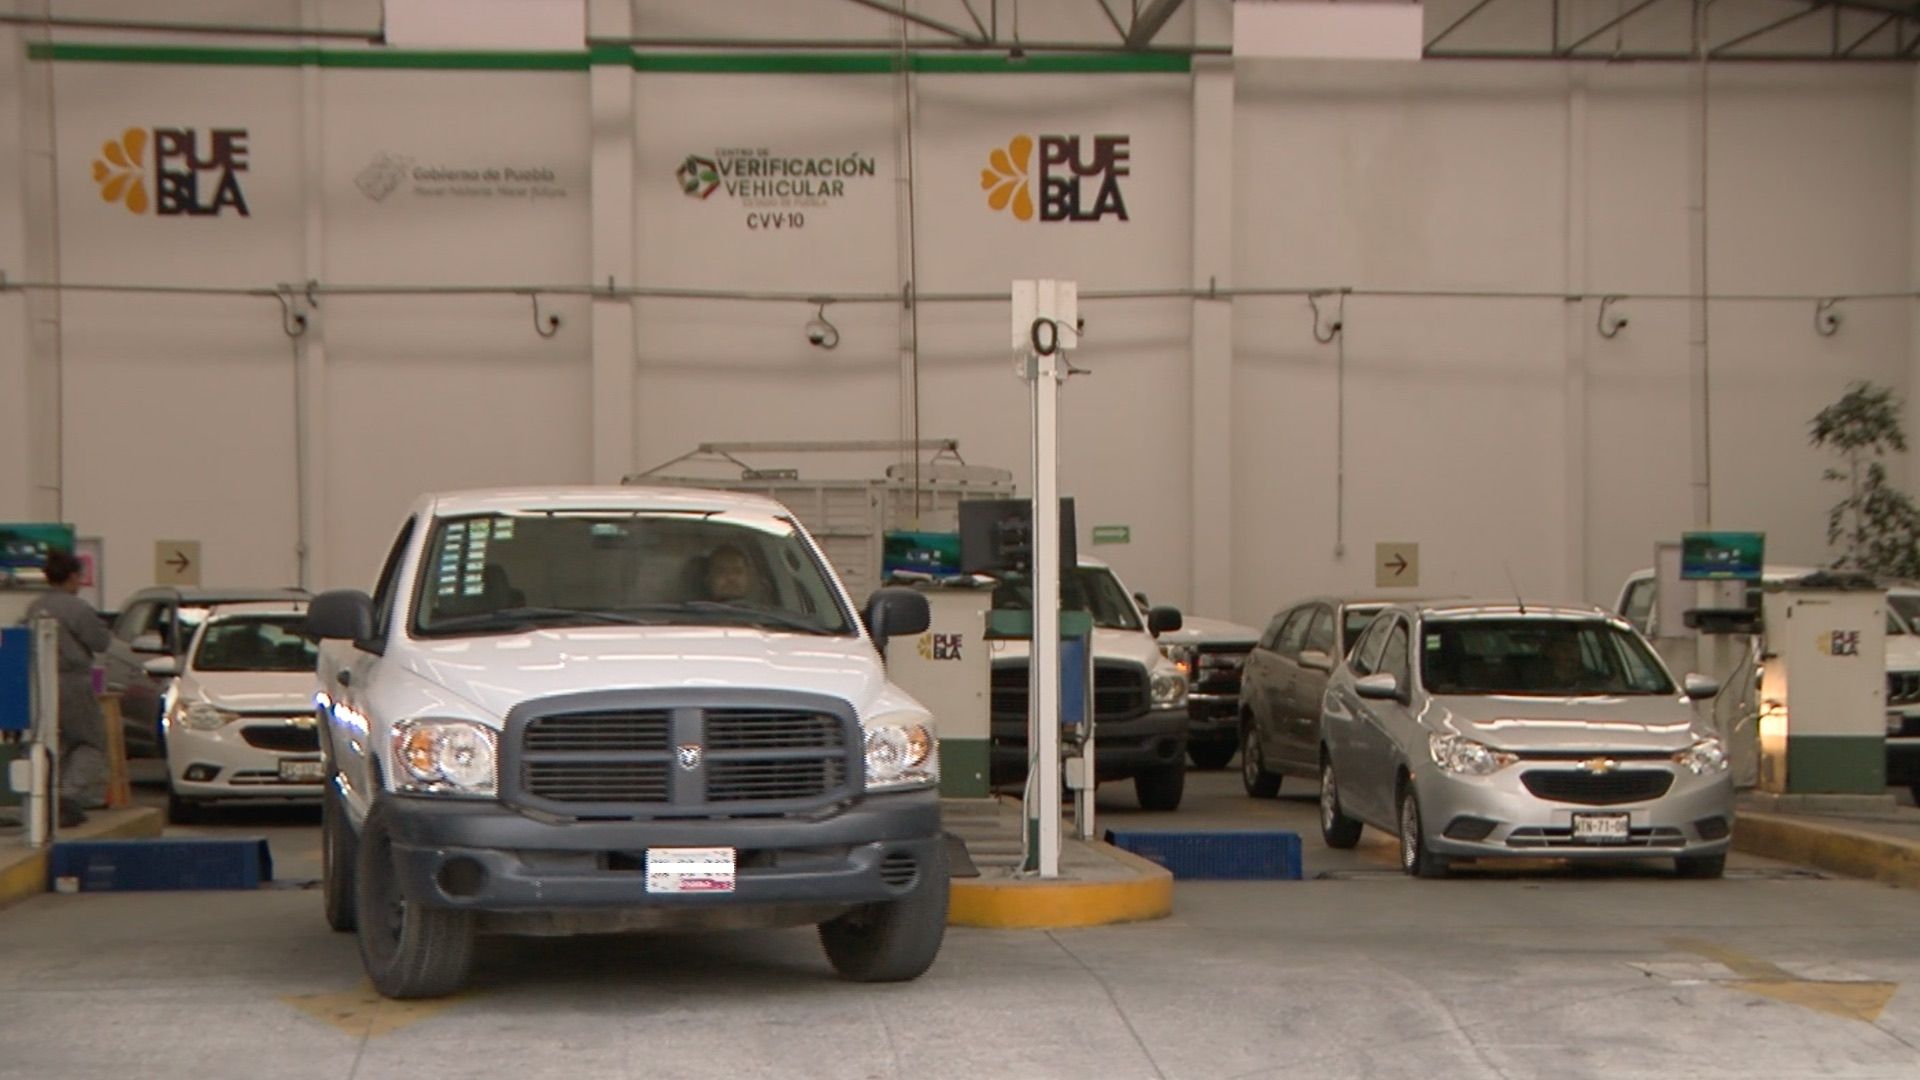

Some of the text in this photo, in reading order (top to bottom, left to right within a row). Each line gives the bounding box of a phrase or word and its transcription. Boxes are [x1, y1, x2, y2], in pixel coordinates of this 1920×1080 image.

[154, 129, 248, 170] PUE
[718, 152, 875, 177] VERIFICACIÓN
[1039, 134, 1130, 176] PUE
[156, 168, 249, 215] BLA
[725, 180, 844, 197] VEHICULAR
[1040, 174, 1129, 222] BLA
